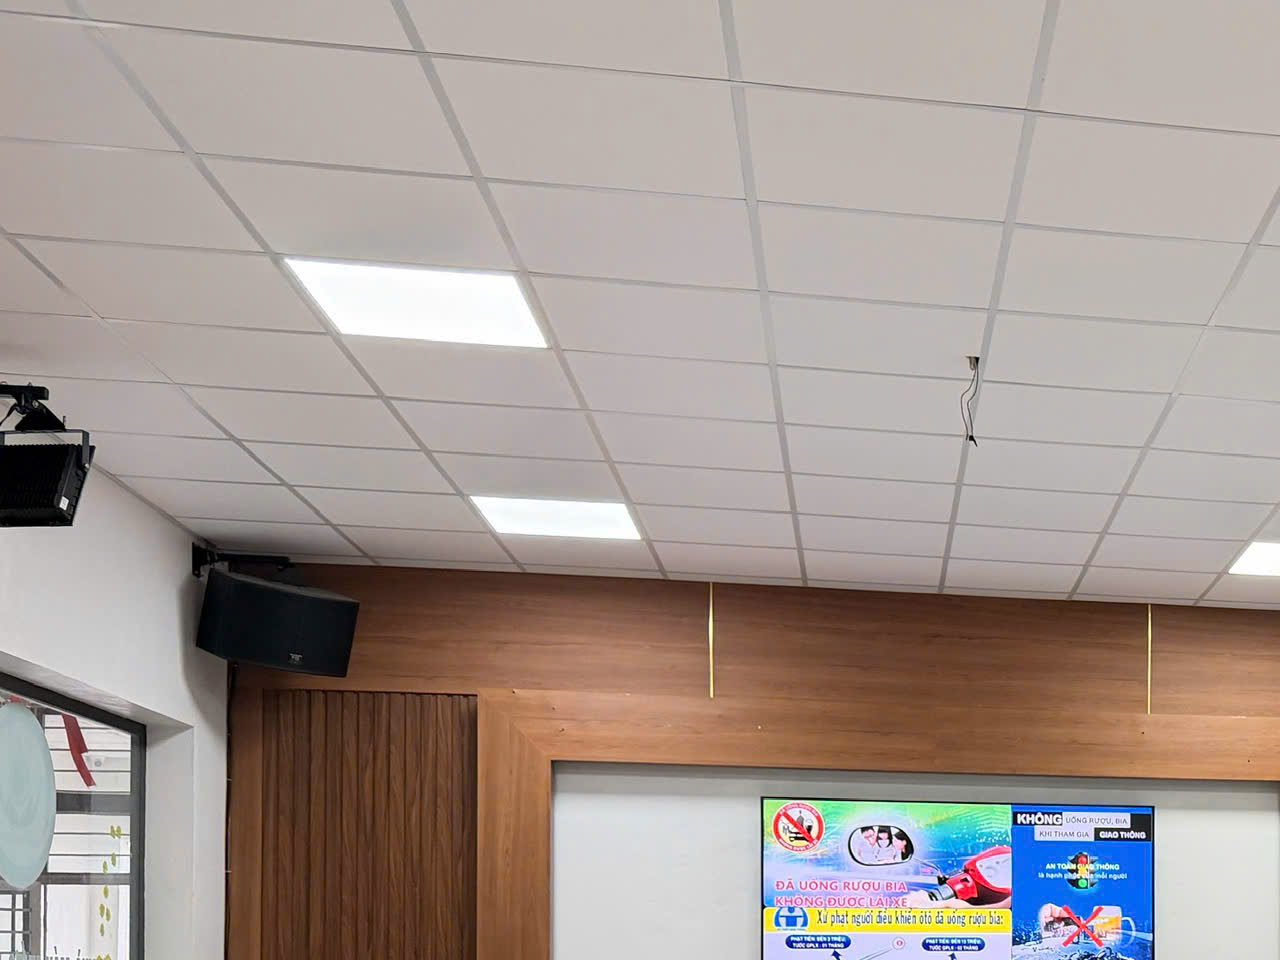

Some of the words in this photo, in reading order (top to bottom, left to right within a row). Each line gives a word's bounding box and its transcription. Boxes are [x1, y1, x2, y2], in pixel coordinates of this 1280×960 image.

[1016, 811, 1062, 825] KHÔNG
[1099, 830, 1119, 839] GIAO
[1119, 829, 1147, 839] THÔNG
[1096, 862, 1120, 870] THÔNG
[775, 878, 795, 891] ĐÃ
[799, 877, 838, 891] UỐNG
[843, 880, 881, 893] RƯỢU
[885, 881, 908, 892] BIA
[775, 894, 823, 907] KHÔNG
[893, 897, 908, 907] XE
[831, 910, 848, 927] phạt
[851, 910, 873, 926] người
[876, 908, 892, 924] điều
[895, 908, 916, 924] khiển
[935, 911, 944, 924] đã
[947, 909, 966, 927] uống
[969, 912, 987, 927] rượu
